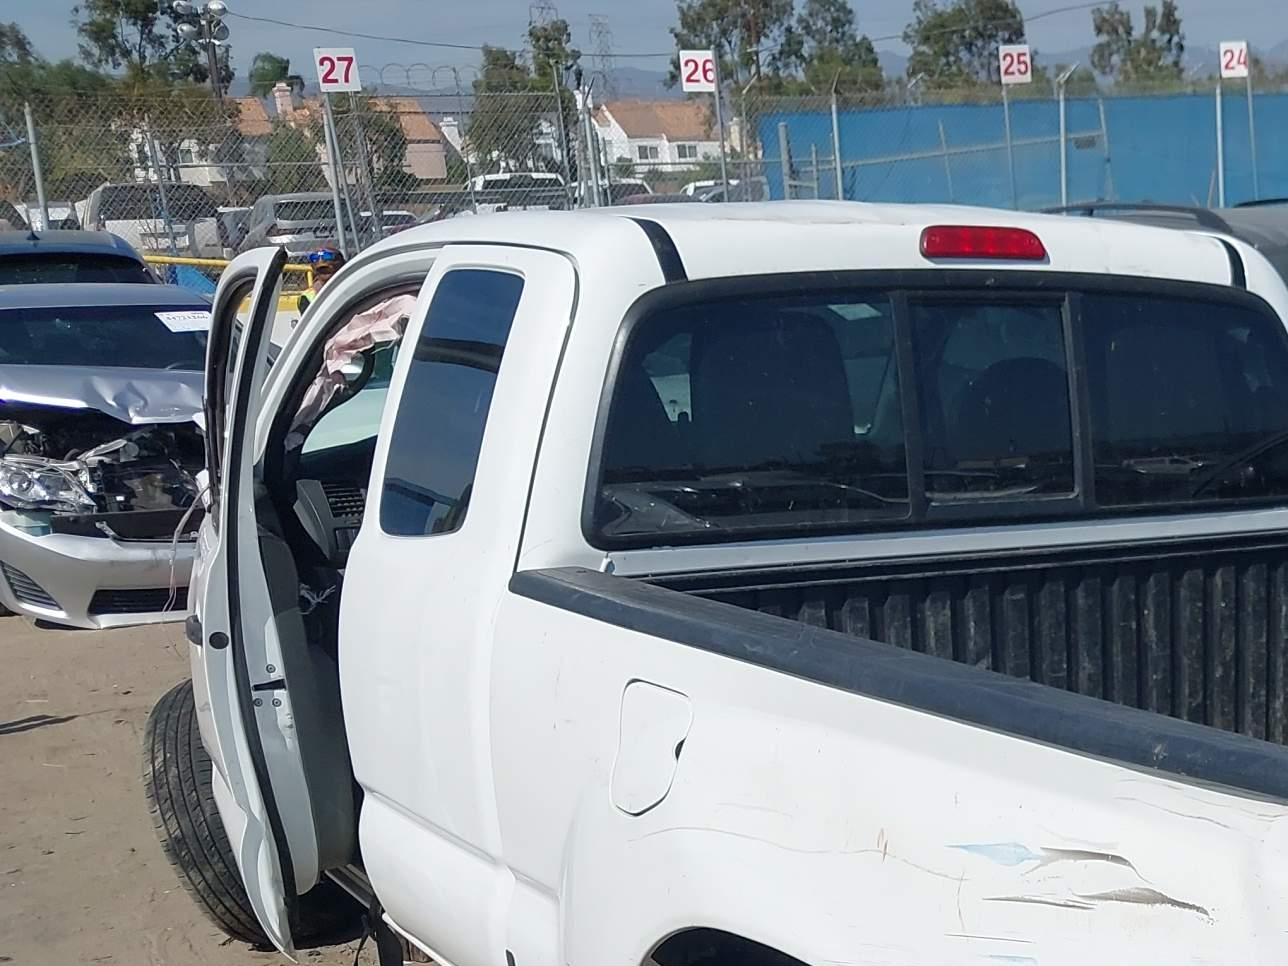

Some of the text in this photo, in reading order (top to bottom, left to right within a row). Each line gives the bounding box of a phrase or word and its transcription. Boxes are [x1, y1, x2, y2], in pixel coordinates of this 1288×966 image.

[319, 56, 353, 85] 27
[684, 58, 715, 83] 26
[1003, 52, 1028, 76] 25
[1223, 49, 1247, 70] 24
